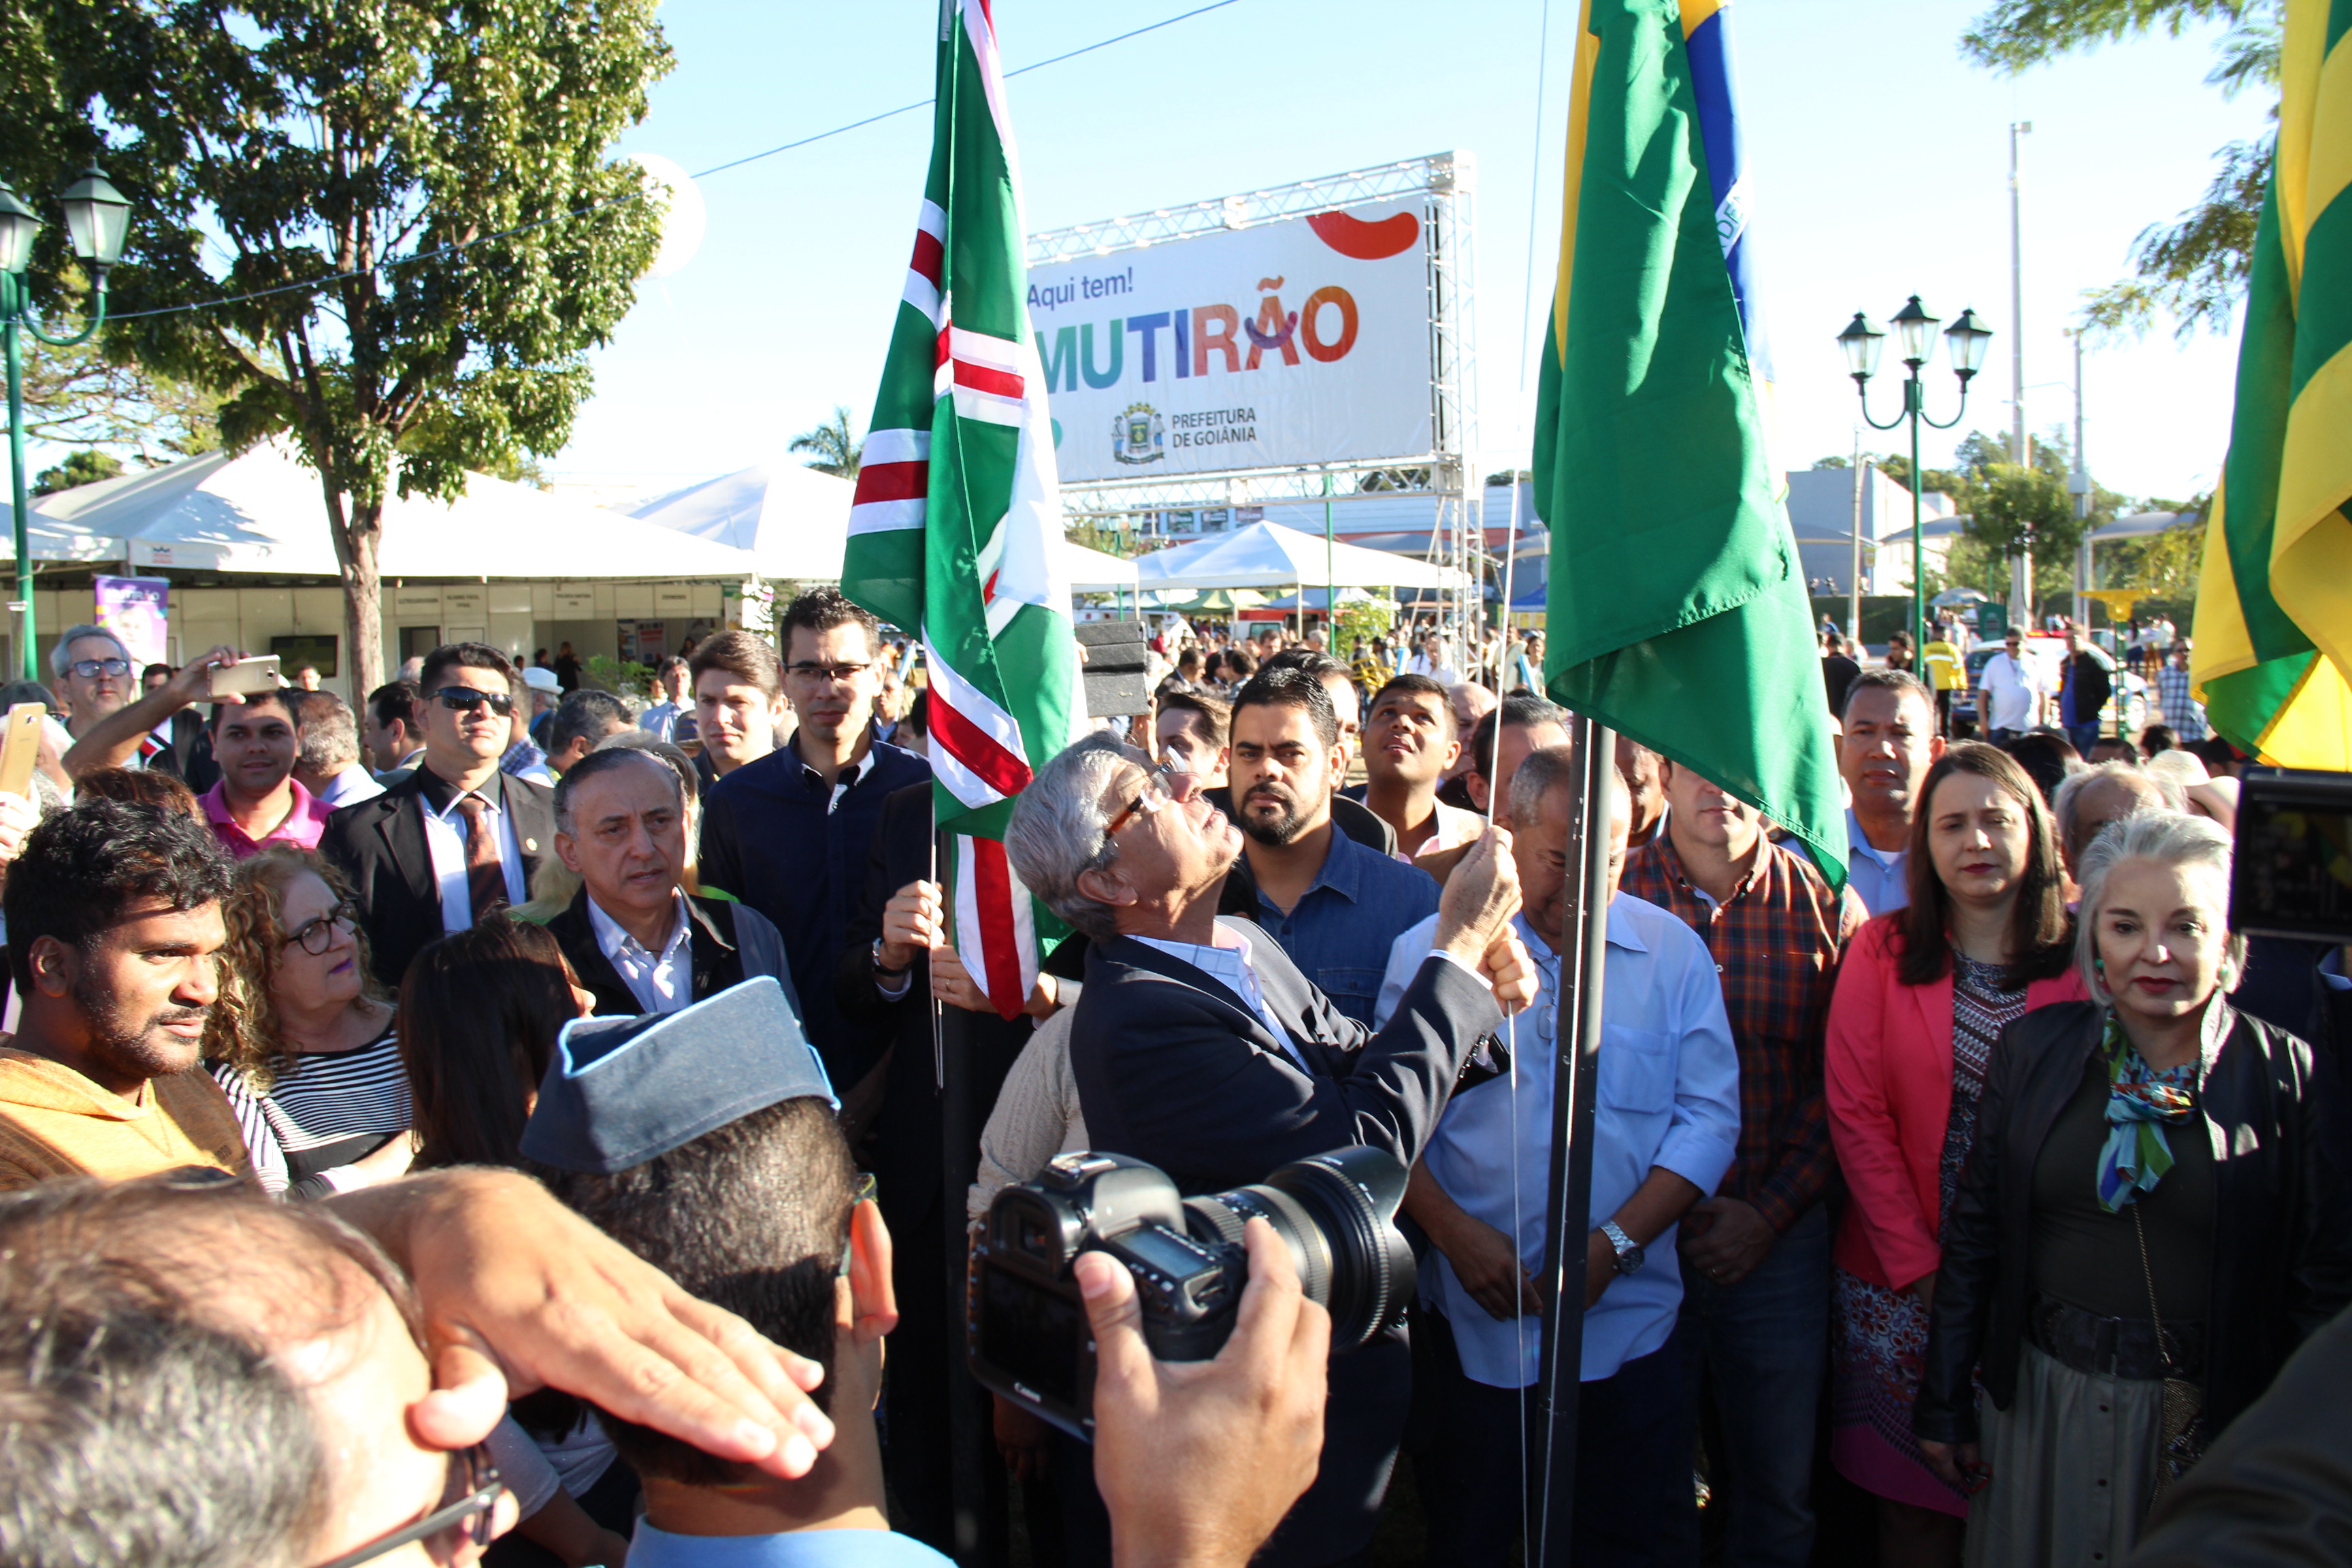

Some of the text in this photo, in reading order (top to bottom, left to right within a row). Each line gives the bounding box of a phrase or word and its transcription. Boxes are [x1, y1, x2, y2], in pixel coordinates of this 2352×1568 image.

[1028, 266, 1133, 311] Aqui tem!
[1034, 275, 1359, 395] MUTIRÃO
[1172, 408, 1256, 430] PREFEITURA
[1173, 425, 1257, 448] DE GOIÂNIA
